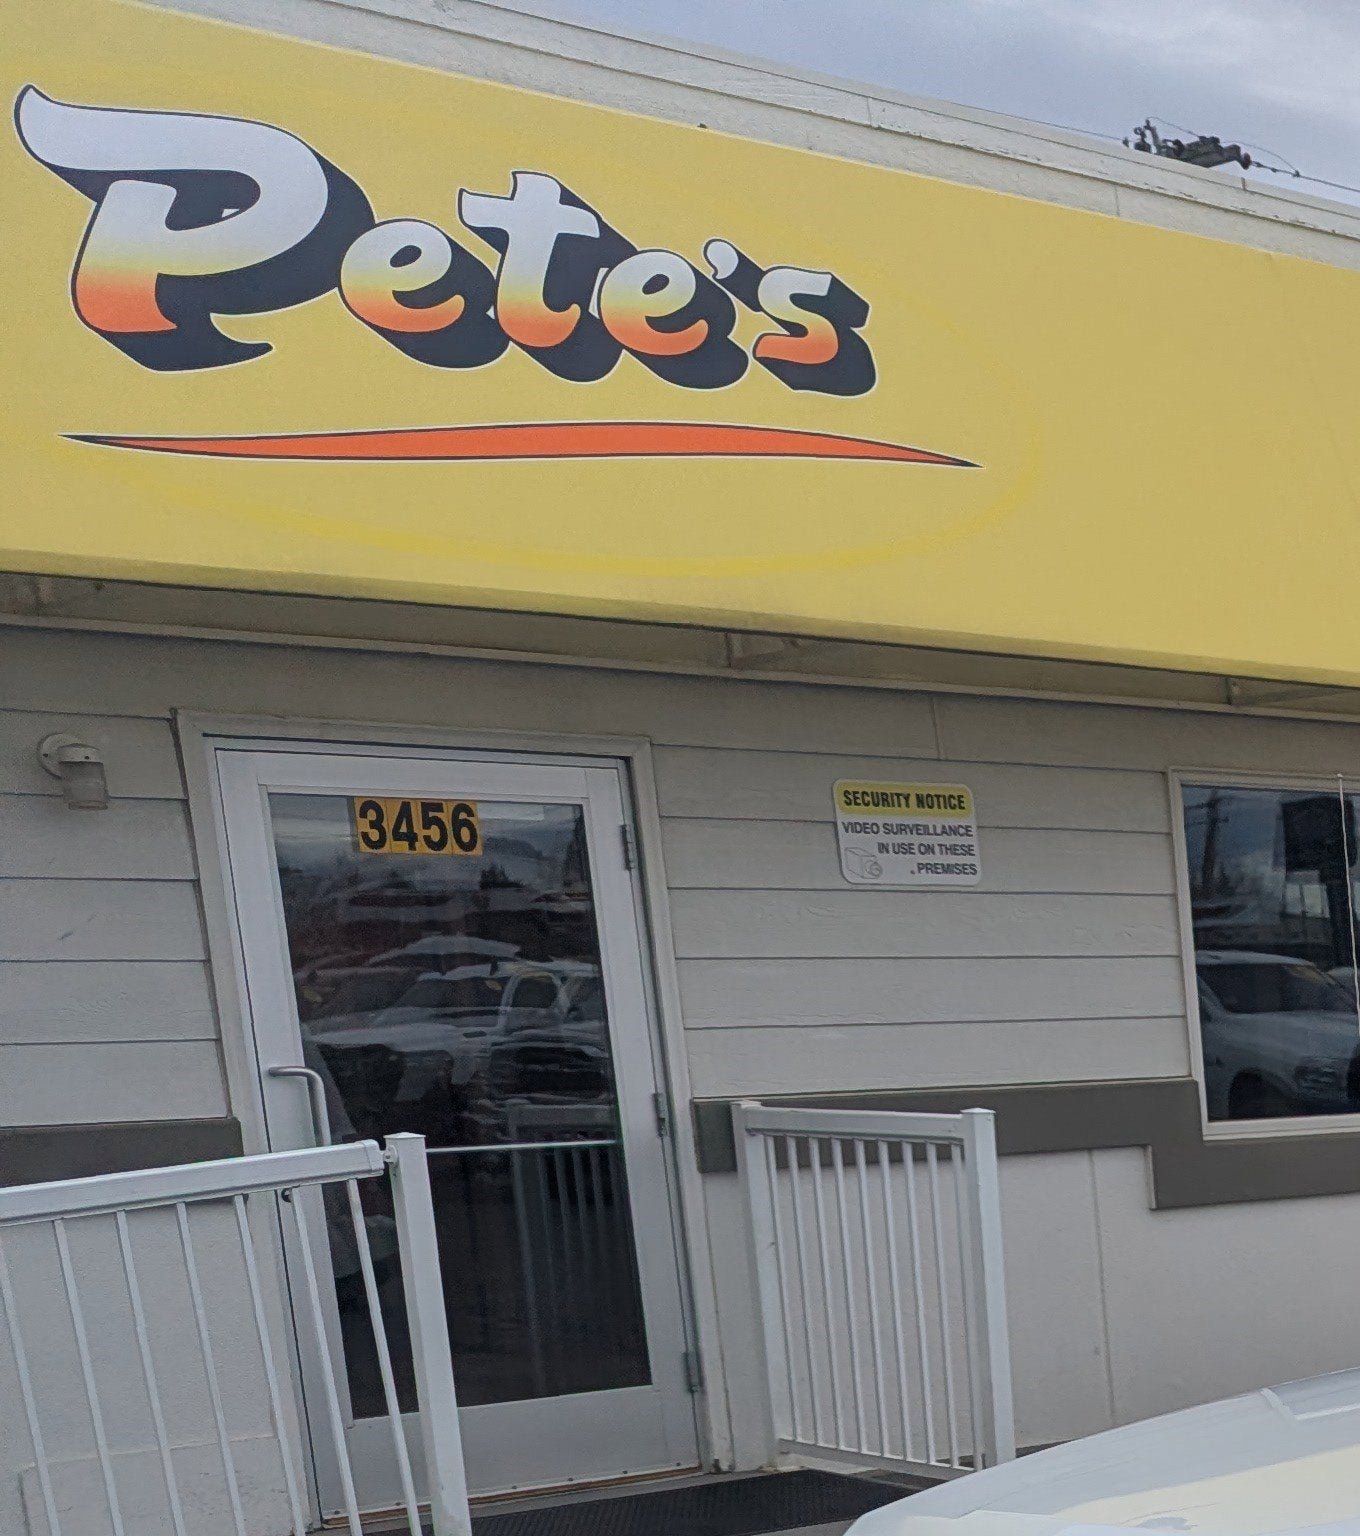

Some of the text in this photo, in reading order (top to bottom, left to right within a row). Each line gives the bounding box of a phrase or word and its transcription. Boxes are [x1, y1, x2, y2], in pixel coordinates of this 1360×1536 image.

[14, 84, 877, 397] Pete's
[843, 790, 966, 810] SECURITY NOTICE
[359, 800, 478, 852] 3456
[841, 821, 974, 837] VIDEO SURVEILLANCE
[877, 841, 976, 857] IN USE ON THESE
[917, 862, 978, 876] PREMISES
